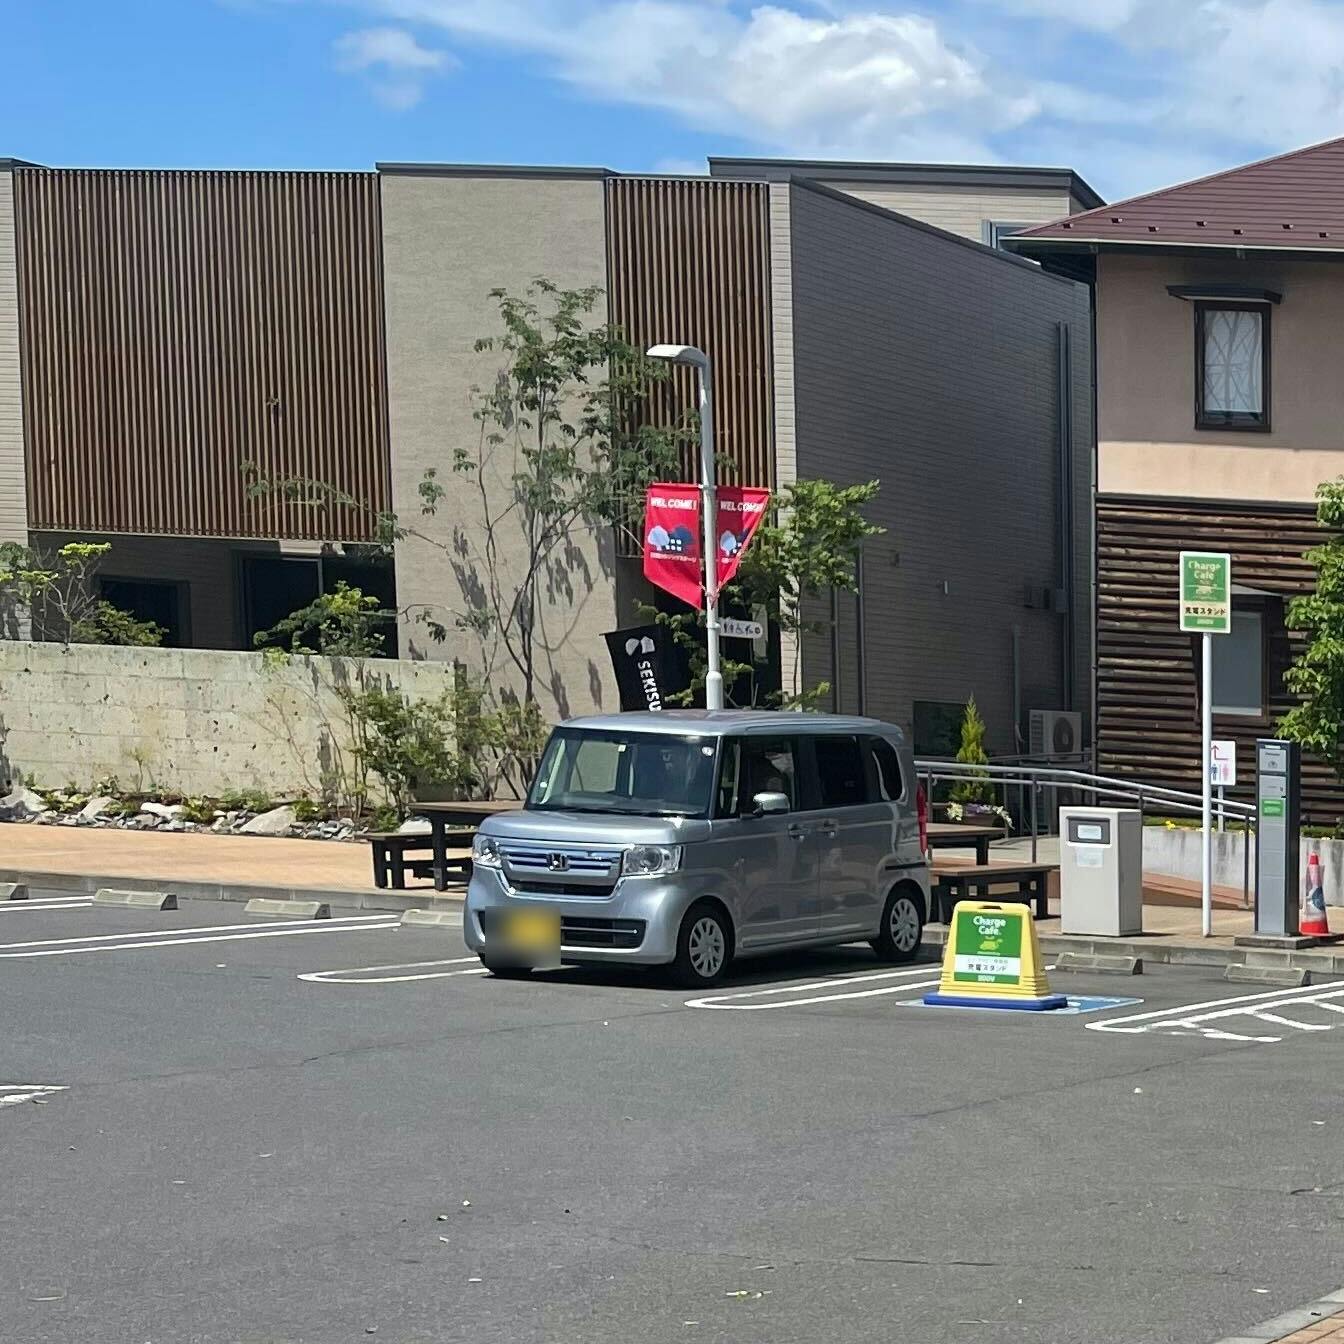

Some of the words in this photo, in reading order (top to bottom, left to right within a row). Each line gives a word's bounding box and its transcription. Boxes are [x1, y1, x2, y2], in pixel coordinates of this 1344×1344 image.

[1188, 560, 1221, 572] Charge
[1194, 570, 1215, 580] Cafe
[973, 916, 1006, 928] Charge
